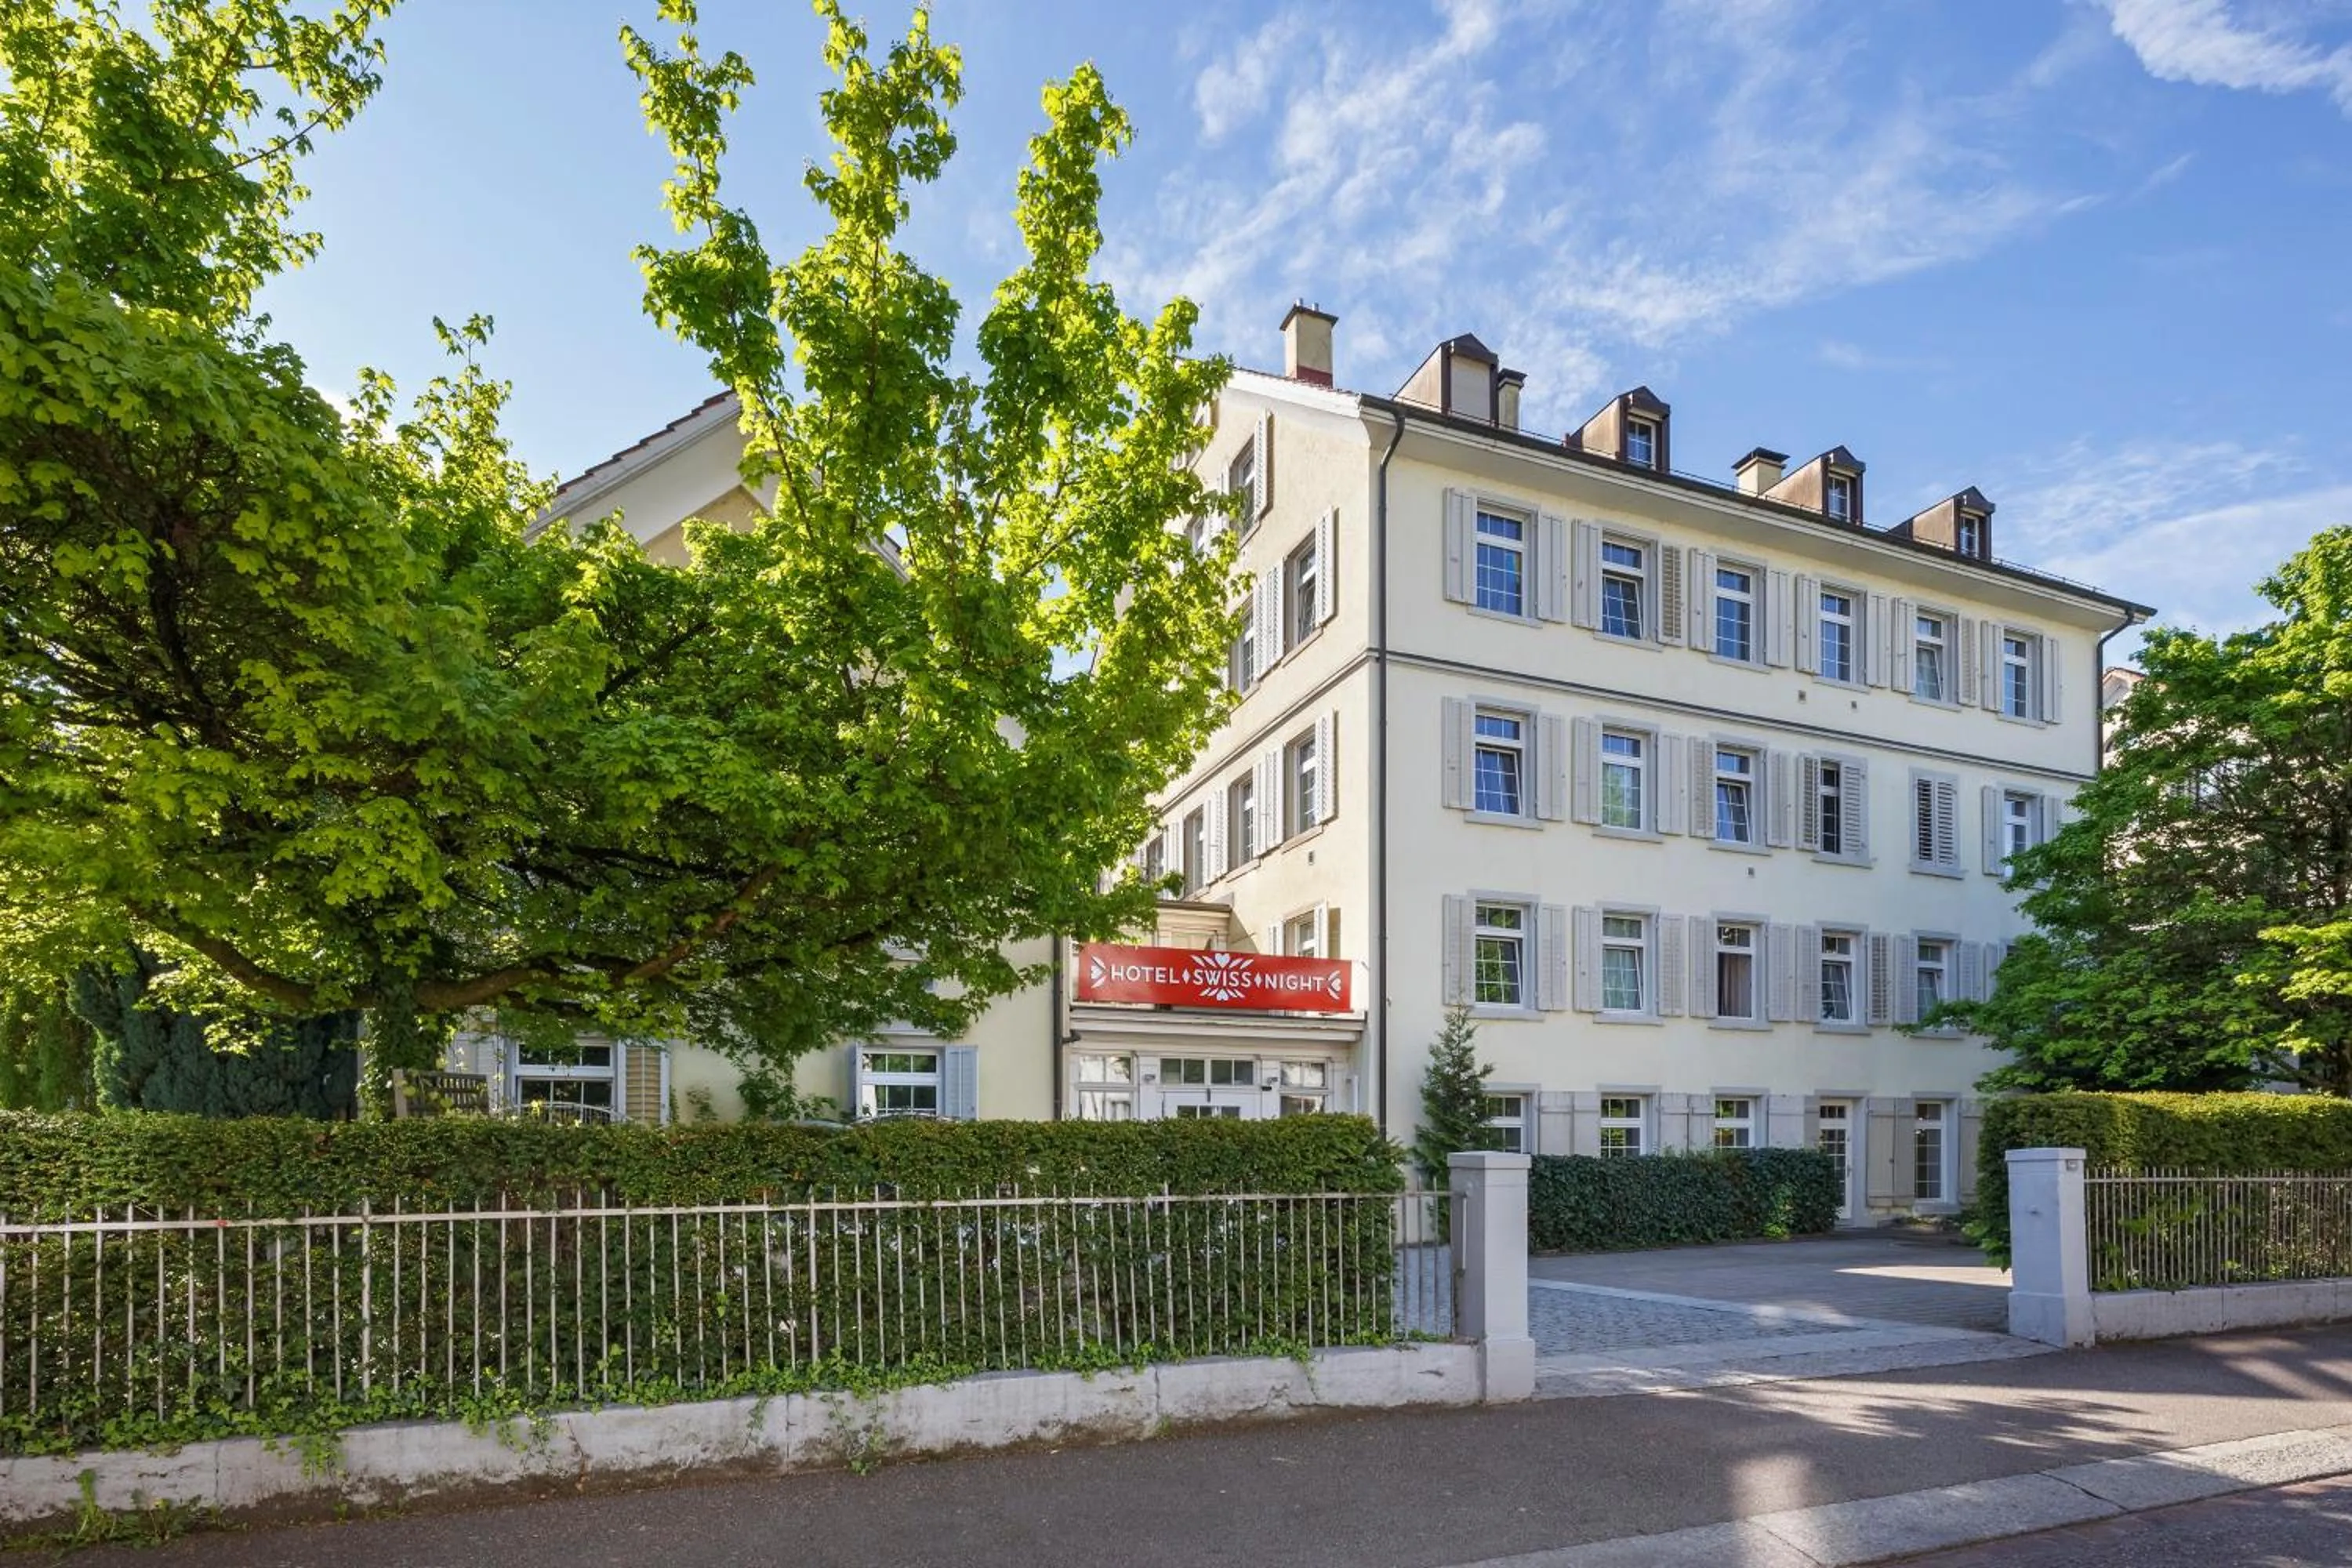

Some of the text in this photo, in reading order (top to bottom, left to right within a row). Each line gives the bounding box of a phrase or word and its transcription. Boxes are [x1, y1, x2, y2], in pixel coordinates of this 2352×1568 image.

[1110, 963, 1325, 992] HOTEL SWISS NIGHT
